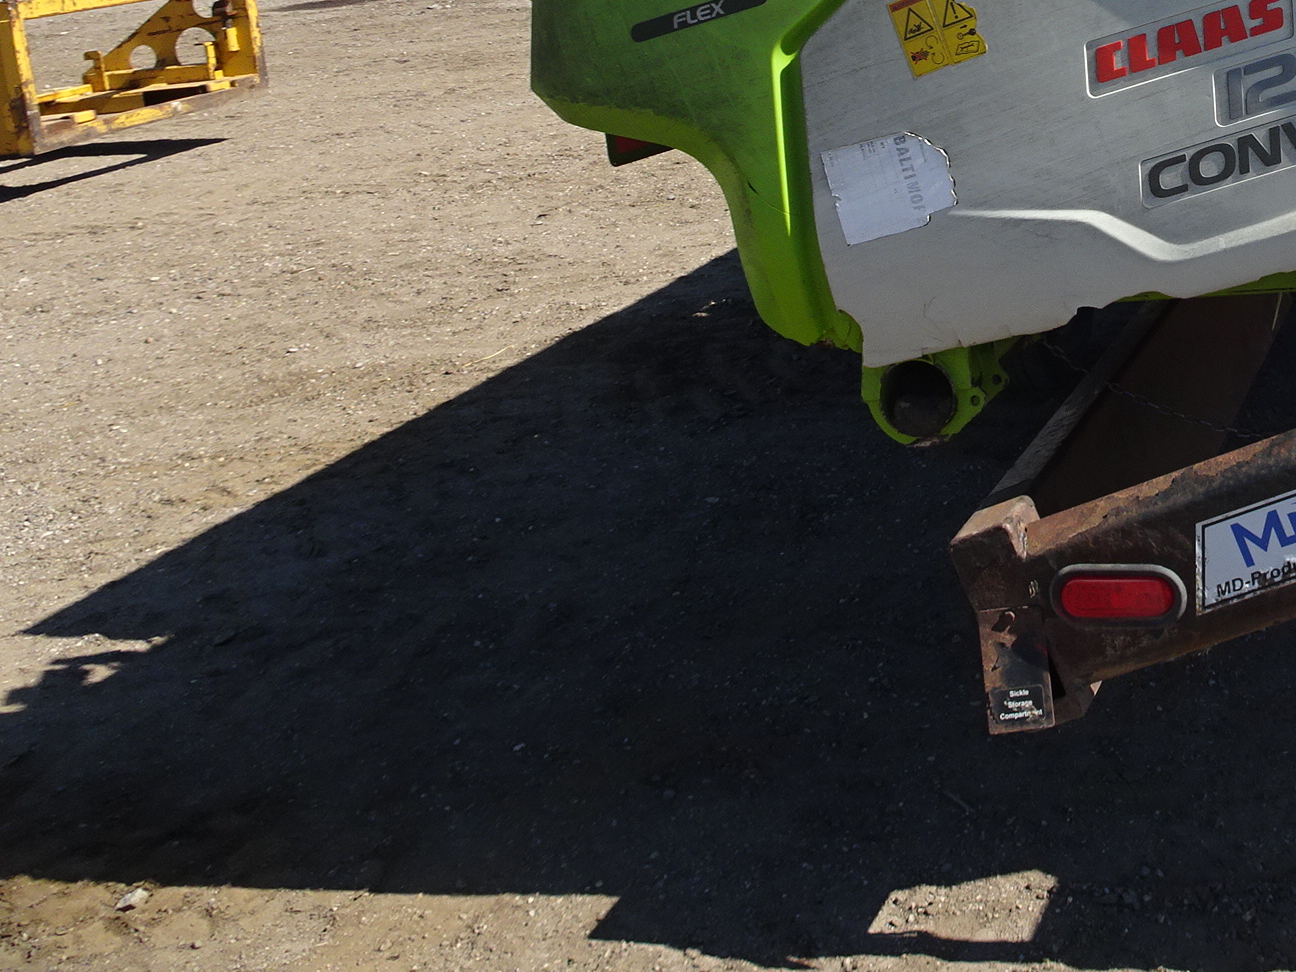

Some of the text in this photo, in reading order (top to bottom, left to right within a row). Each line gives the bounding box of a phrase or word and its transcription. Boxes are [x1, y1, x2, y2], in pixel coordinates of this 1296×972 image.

[673, 0, 726, 29] FLEX
[1009, 689, 1030, 698] Sickle
[1008, 699, 1033, 709] Storage
[1000, 708, 1043, 721] Compartmnt
